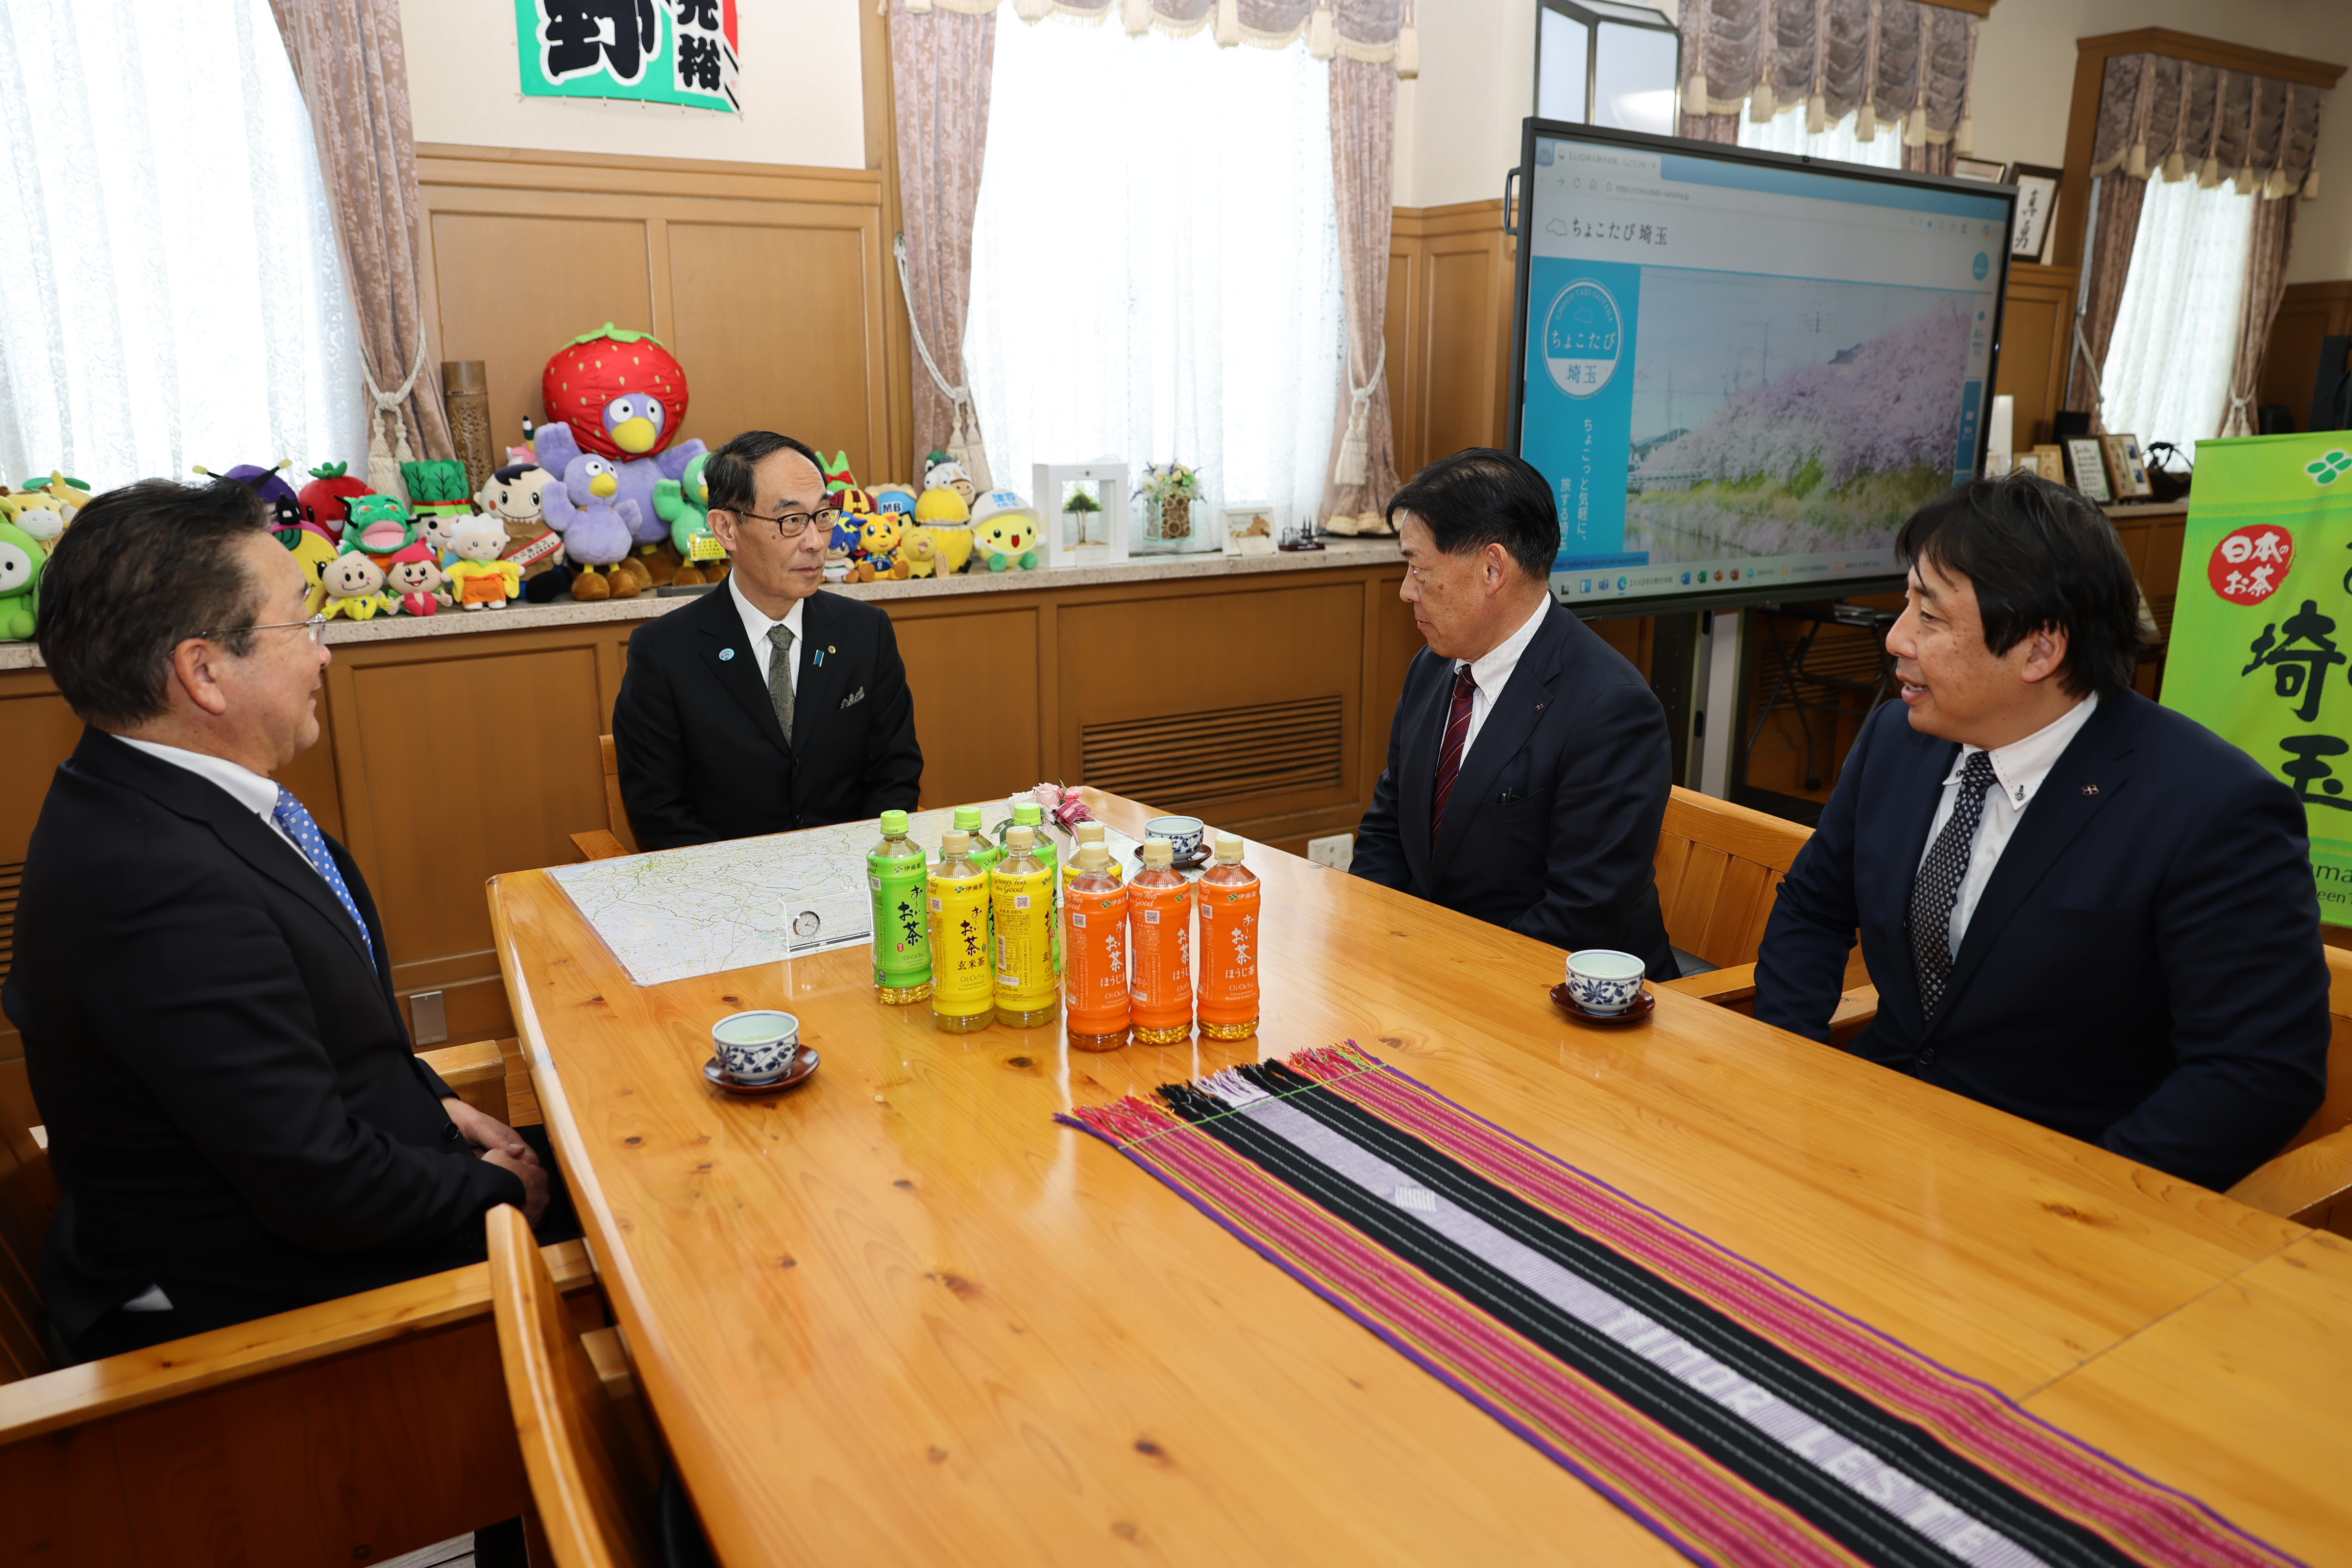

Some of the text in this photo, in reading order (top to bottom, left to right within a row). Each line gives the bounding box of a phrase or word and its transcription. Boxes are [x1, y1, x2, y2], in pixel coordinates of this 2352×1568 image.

[1572, 218, 1667, 245] ちょこたび埼玉
[1555, 292, 1575, 320] CHOCO
[1576, 288, 1592, 297] TABI
[1552, 329, 1617, 351] ちょこたび
[1567, 364, 1597, 384] 埼玉
[1558, 477, 1572, 551] 旅する埼玉
[2221, 531, 2289, 564] 日本の
[2224, 564, 2275, 597] お茶
[2242, 599, 2352, 812] 埼玉
[904, 863, 921, 872] 伊藤園
[965, 882, 983, 892] 伊藤園
[994, 876, 1027, 885] Green Tea
[1004, 885, 1024, 894] Good
[1072, 893, 1083, 903] Tea
[1144, 890, 1157, 899] Tea
[1238, 890, 1256, 900] 伊藤園
[1111, 895, 1126, 906] 伊藤園
[1135, 897, 1154, 906] Good
[898, 901, 923, 946] お茶
[960, 920, 980, 956] お茶
[1231, 928, 1251, 965] お茶
[1105, 934, 1124, 972] お茶
[957, 956, 985, 970] 玄米茶
[970, 972, 984, 981] Ocha
[1225, 965, 1254, 979] ほうじ茶
[1239, 982, 1253, 990] Ocha
[1602, 1307, 2001, 1559] TIMOR LESTE
